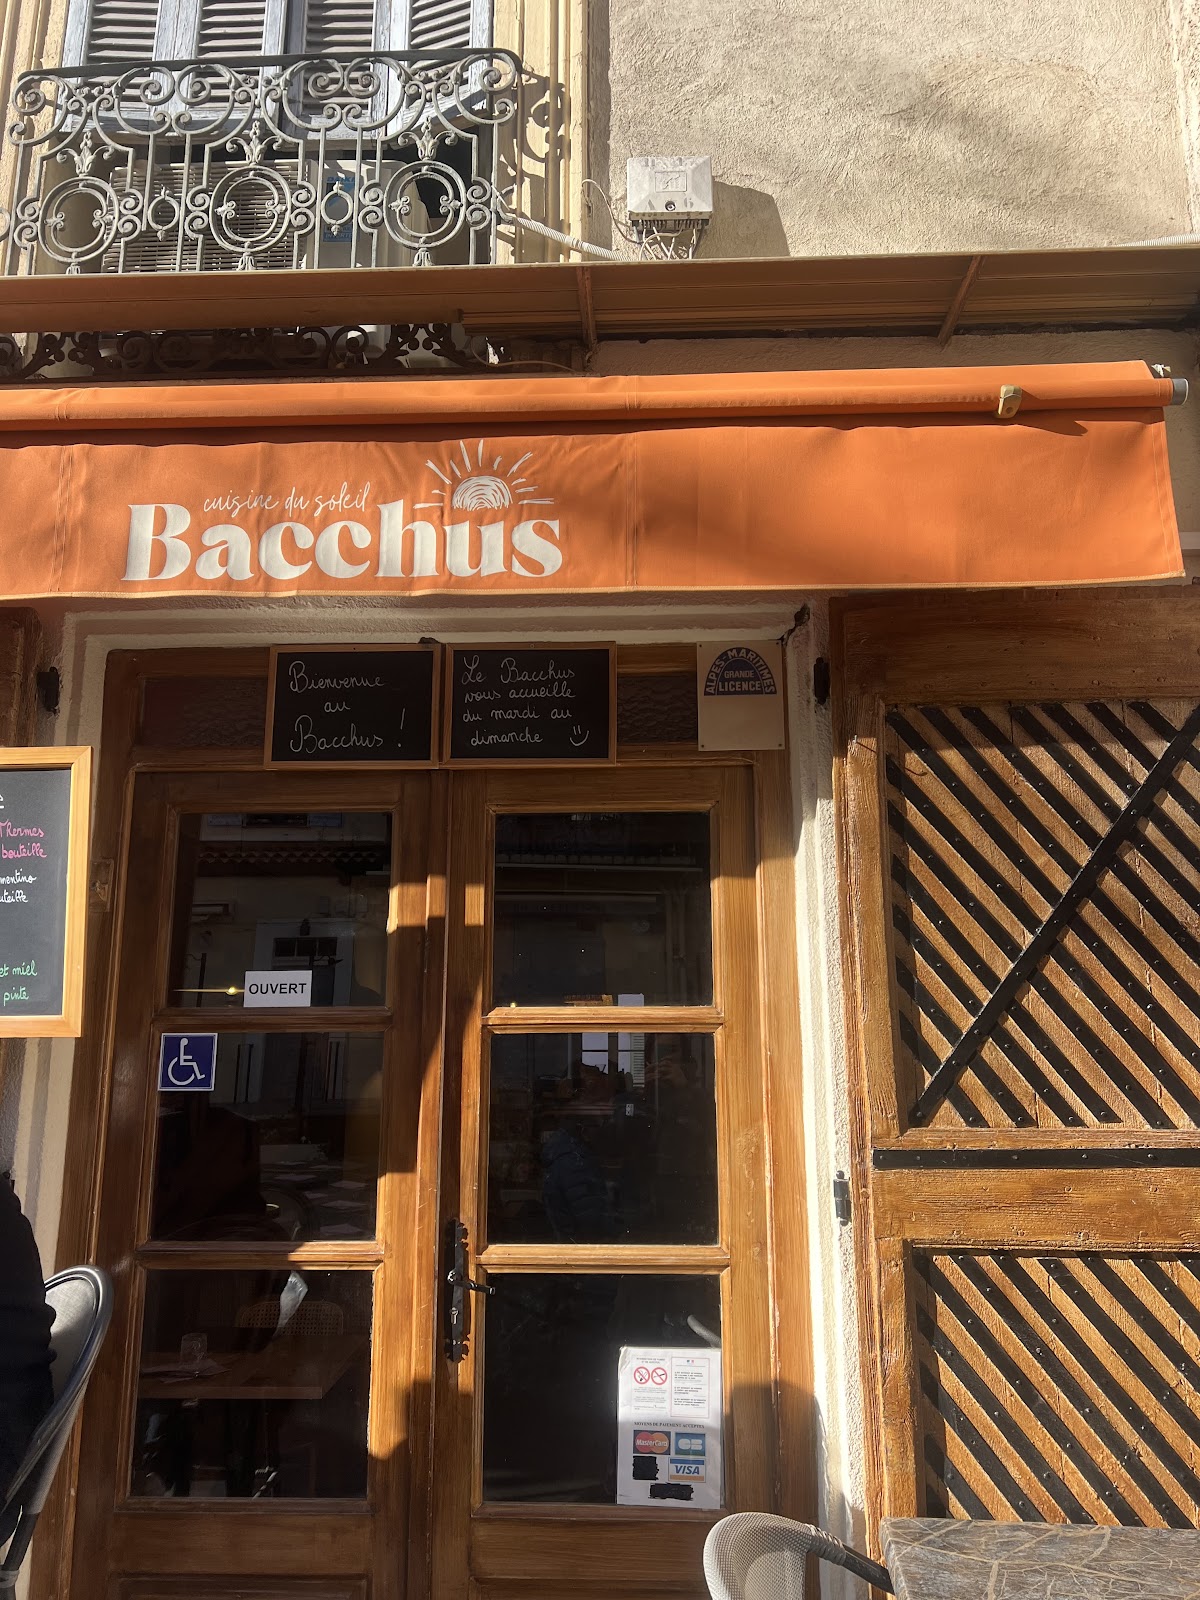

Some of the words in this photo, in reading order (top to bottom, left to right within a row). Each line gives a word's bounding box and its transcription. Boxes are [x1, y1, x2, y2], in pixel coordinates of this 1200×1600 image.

[203, 489, 280, 518] cuisine
[284, 487, 309, 517] du
[314, 481, 371, 518] soleil
[121, 499, 563, 582] Bacchus
[289, 660, 386, 694] Bienvenue
[461, 654, 486, 685] Le
[500, 657, 576, 684] Bacchus
[724, 670, 754, 679] GRANDE
[464, 690, 501, 704] vous
[509, 681, 576, 699] accueille
[718, 680, 762, 692] LICENCE
[324, 701, 350, 713] au
[462, 708, 482, 723] du
[490, 703, 540, 720] mardi
[550, 708, 572, 720] au
[470, 726, 543, 747] dimanche
[2, 842, 48, 859] bouteille
[12, 959, 38, 977] miel
[3, 986, 30, 1007] pinte
[248, 983, 307, 995] OUVERT
[636, 1439, 668, 1447] MasterCard
[674, 1465, 700, 1475] VISA
